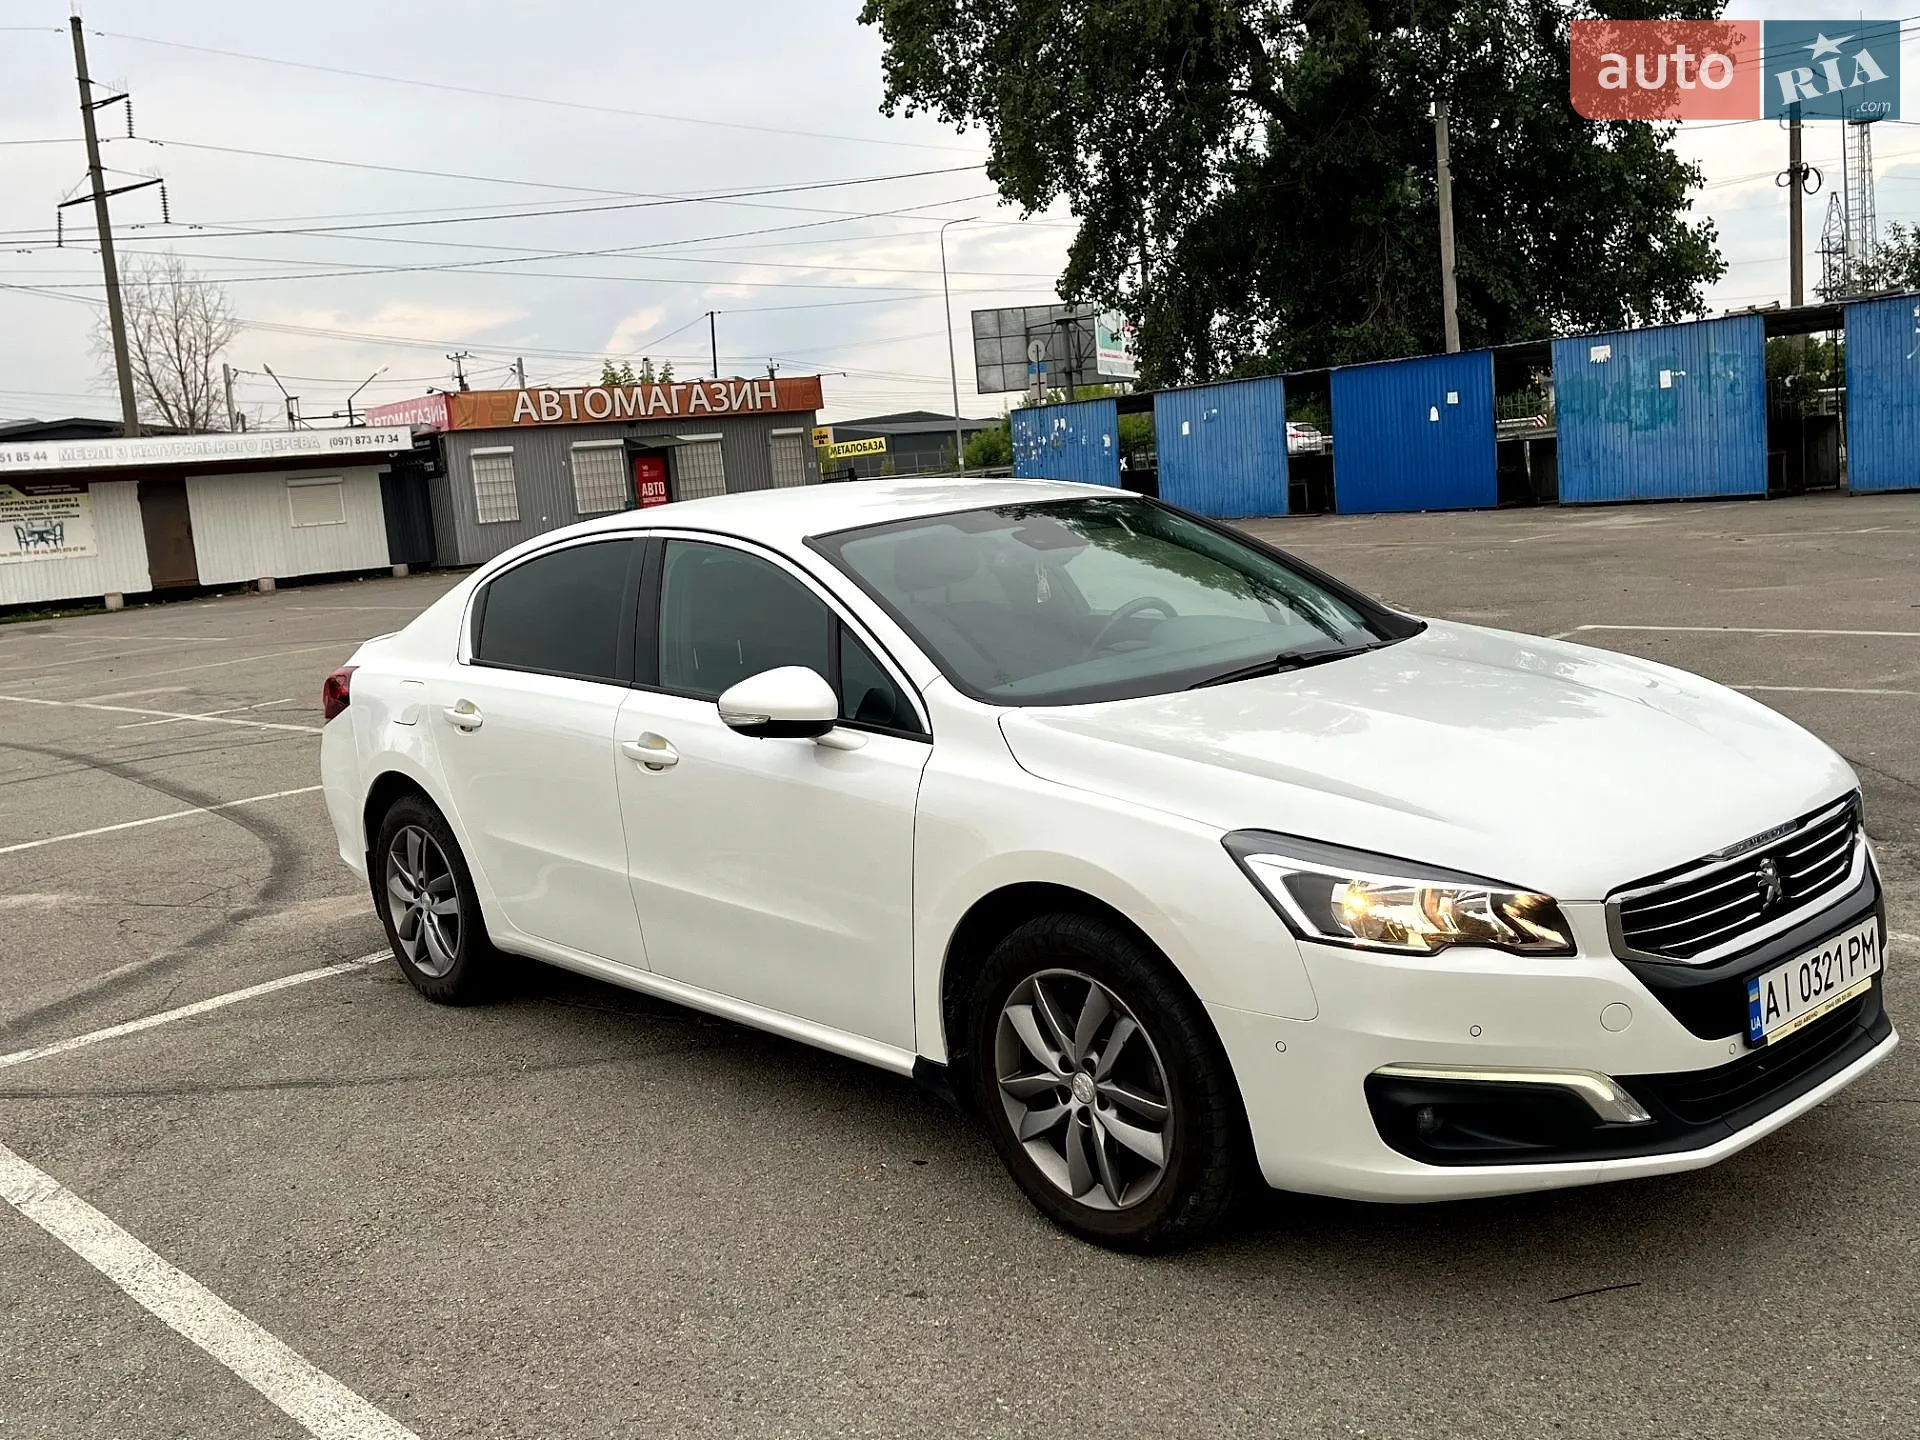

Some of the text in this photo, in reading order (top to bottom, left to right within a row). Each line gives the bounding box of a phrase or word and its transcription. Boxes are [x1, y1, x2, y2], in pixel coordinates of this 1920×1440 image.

[512, 380, 778, 424] АВТОМАГАЗИН
[16, 451, 31, 462] 85
[33, 451, 48, 461] 44
[131, 438, 258, 458] НАТУРАЛЬНОГО
[261, 436, 320, 451] ДЕРЕВА
[329, 437, 353, 448] (097)
[355, 435, 372, 445] 873
[374, 435, 385, 444] 47
[388, 434, 399, 443] 34
[830, 440, 885, 456] МЕТАЛОБАЗА
[642, 481, 666, 497] АВТО
[1765, 927, 1876, 1025] AI 0321 PM
[1750, 1015, 1762, 1031] UA
